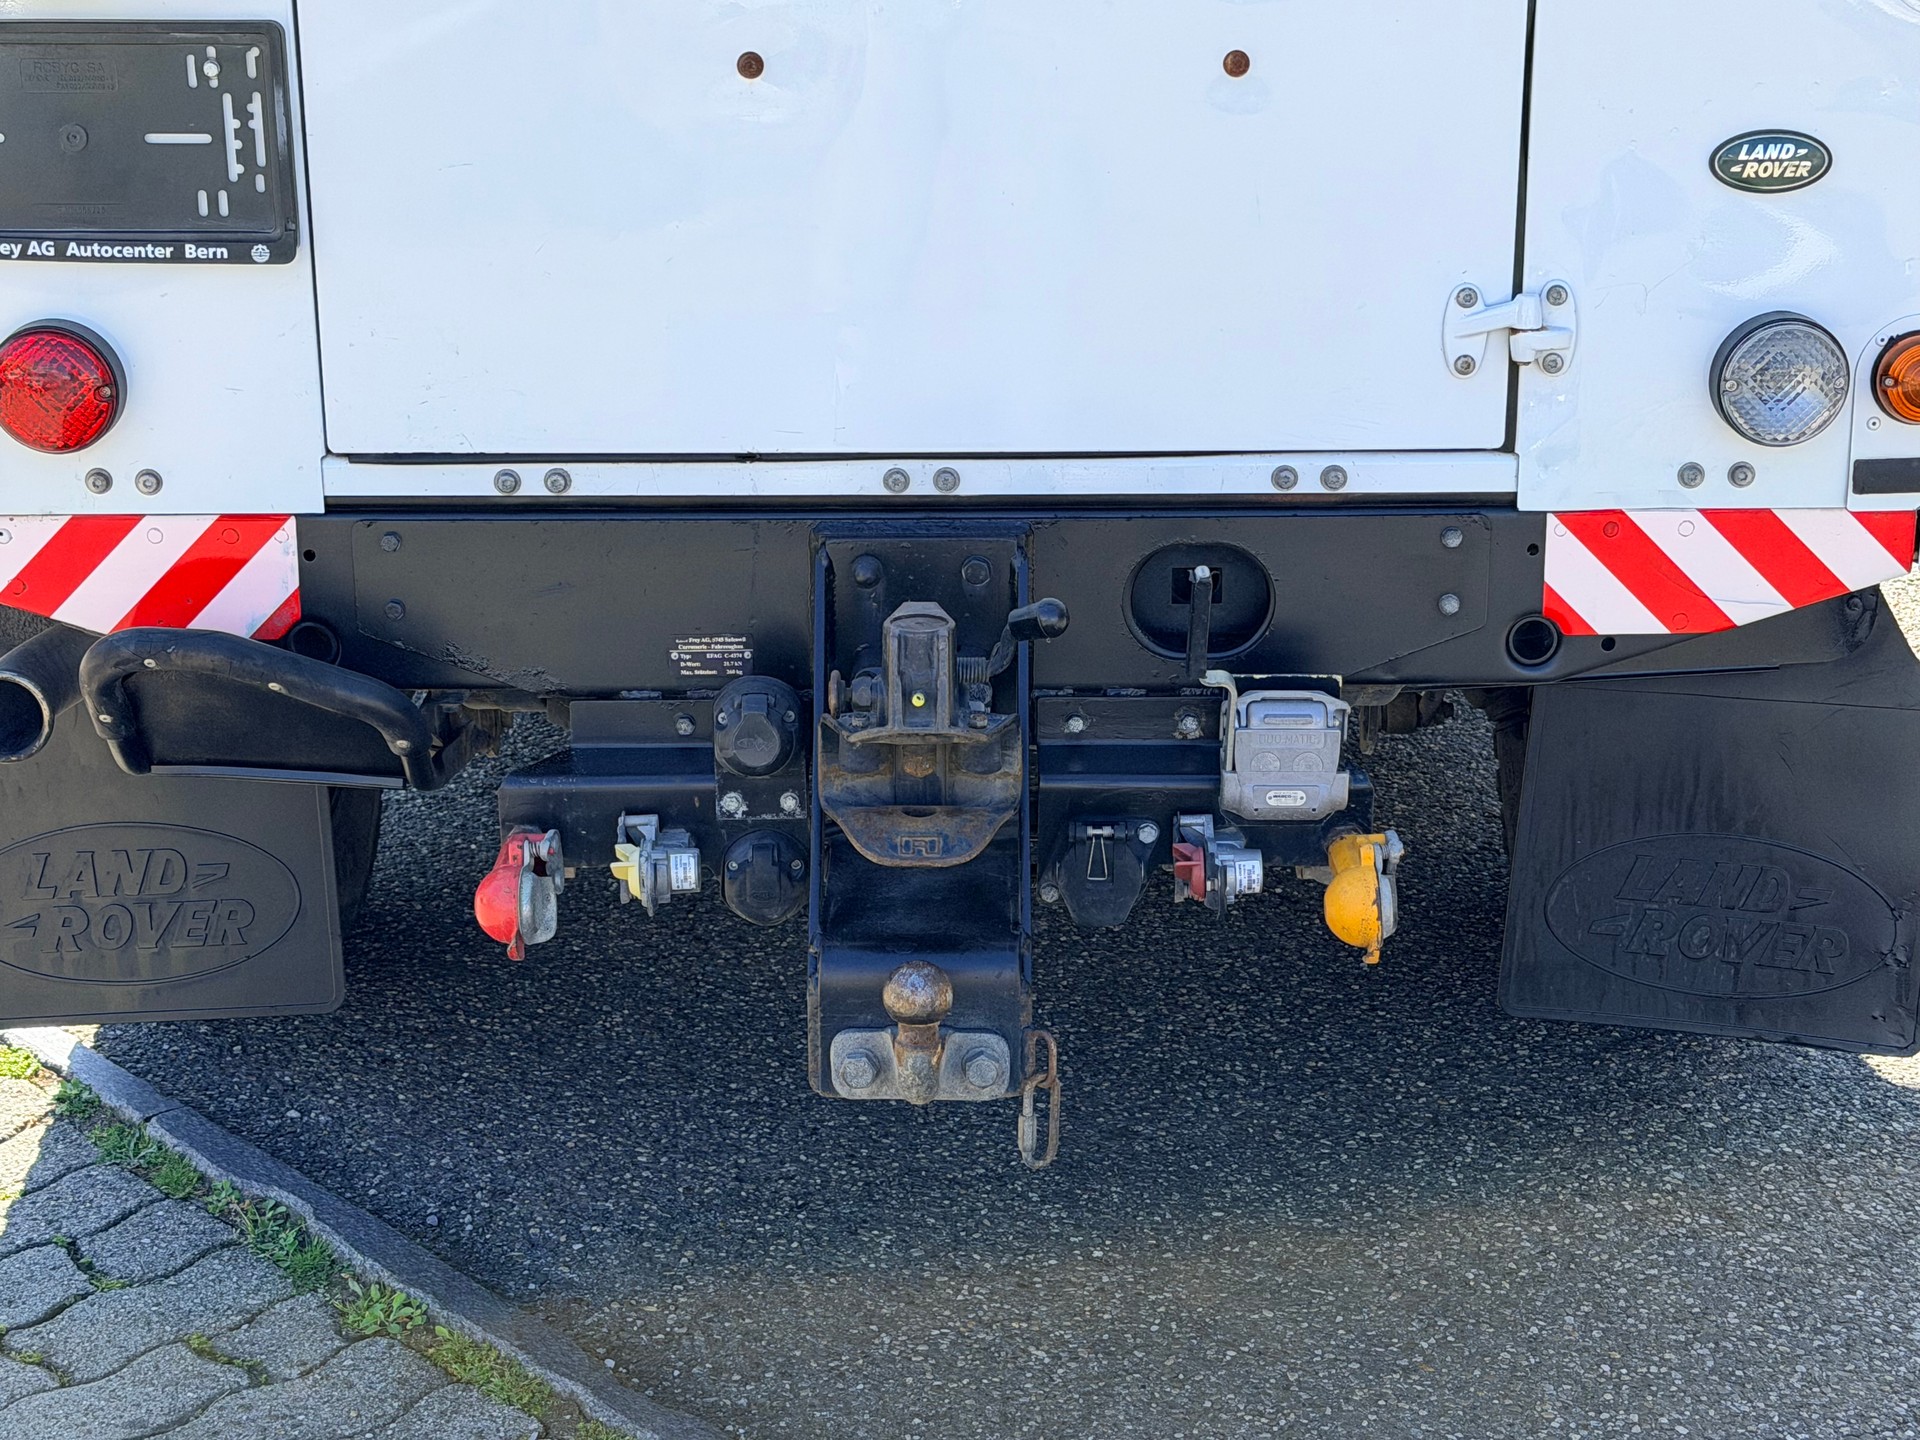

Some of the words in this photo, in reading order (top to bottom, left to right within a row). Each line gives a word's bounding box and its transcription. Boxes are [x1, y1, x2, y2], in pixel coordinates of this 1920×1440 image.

[1738, 143, 1795, 160] LAND
[1742, 161, 1812, 178] ROVER
[27, 241, 55, 256] AG
[66, 242, 174, 259] Autocenter
[185, 244, 229, 259] Bern
[21, 847, 187, 901] LAND
[1614, 854, 1791, 912] LAND
[40, 897, 255, 953] ROVER
[1623, 907, 1850, 975] ROVER
